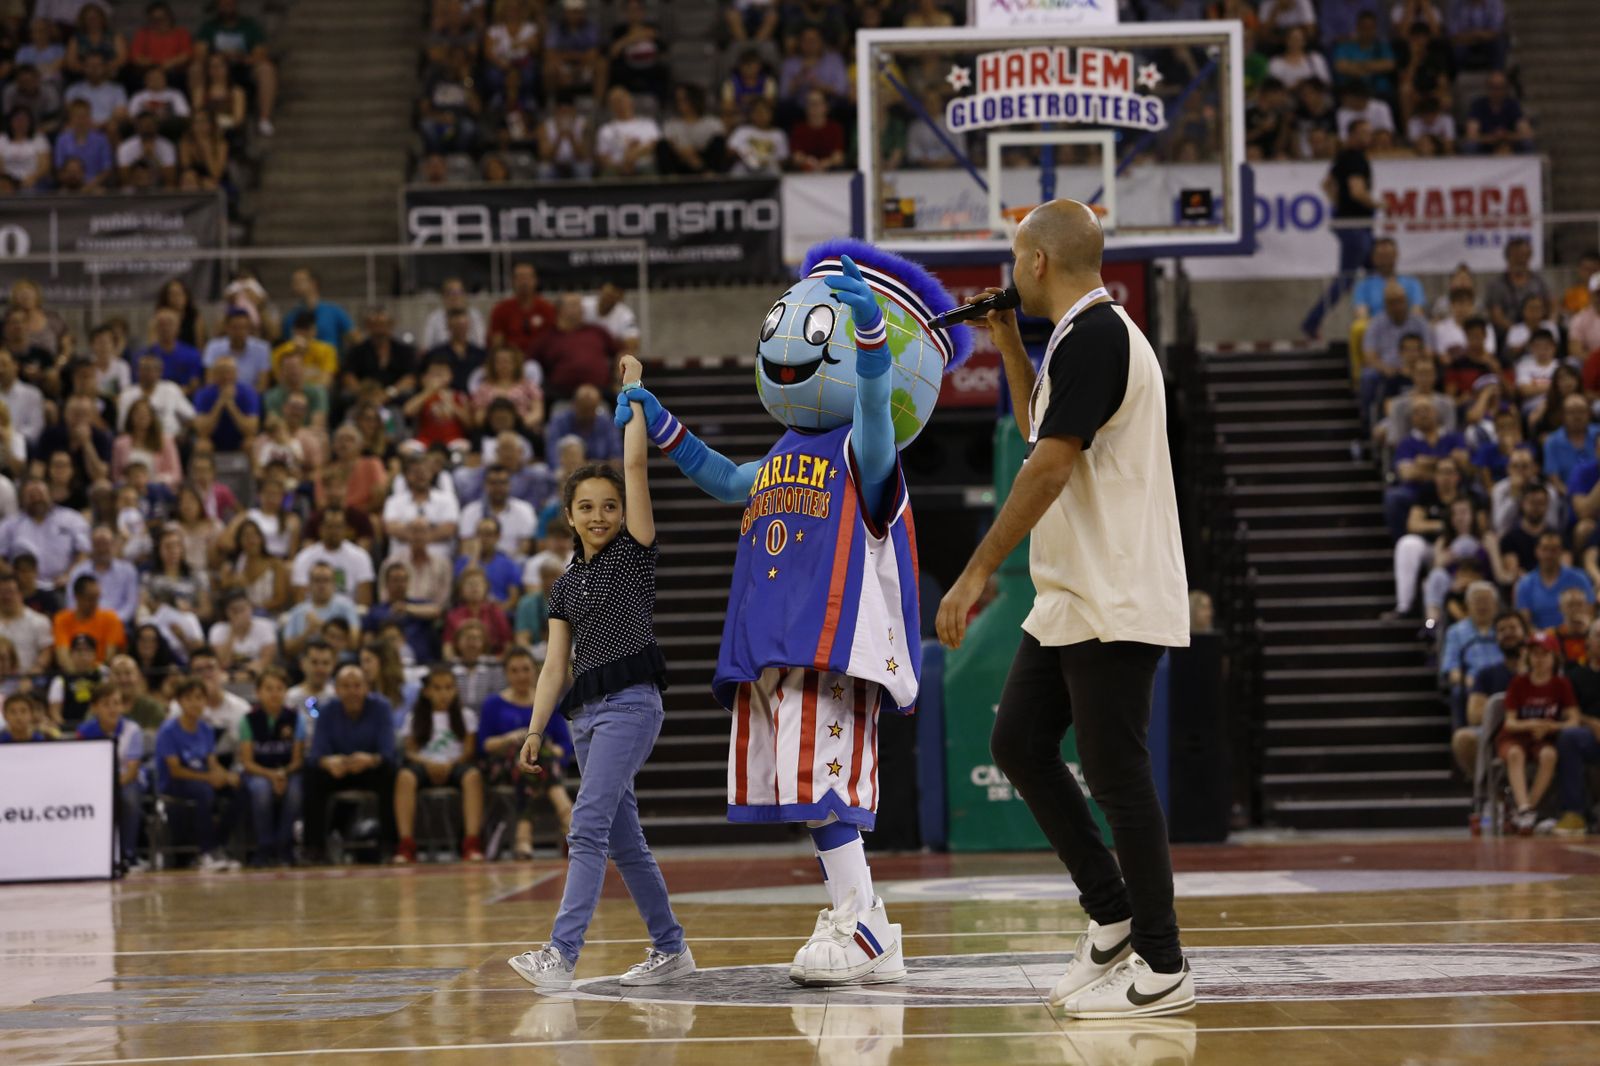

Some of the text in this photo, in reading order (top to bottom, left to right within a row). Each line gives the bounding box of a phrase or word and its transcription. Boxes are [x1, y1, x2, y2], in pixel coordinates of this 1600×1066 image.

[979, 49, 1131, 93] HARLEM
[949, 92, 1162, 129] GLOBETROTTERS
[1382, 184, 1533, 233] MARCA
[749, 453, 830, 497] HARLEM
[740, 486, 832, 537] GBETROTTES
[765, 519, 788, 556] 0
